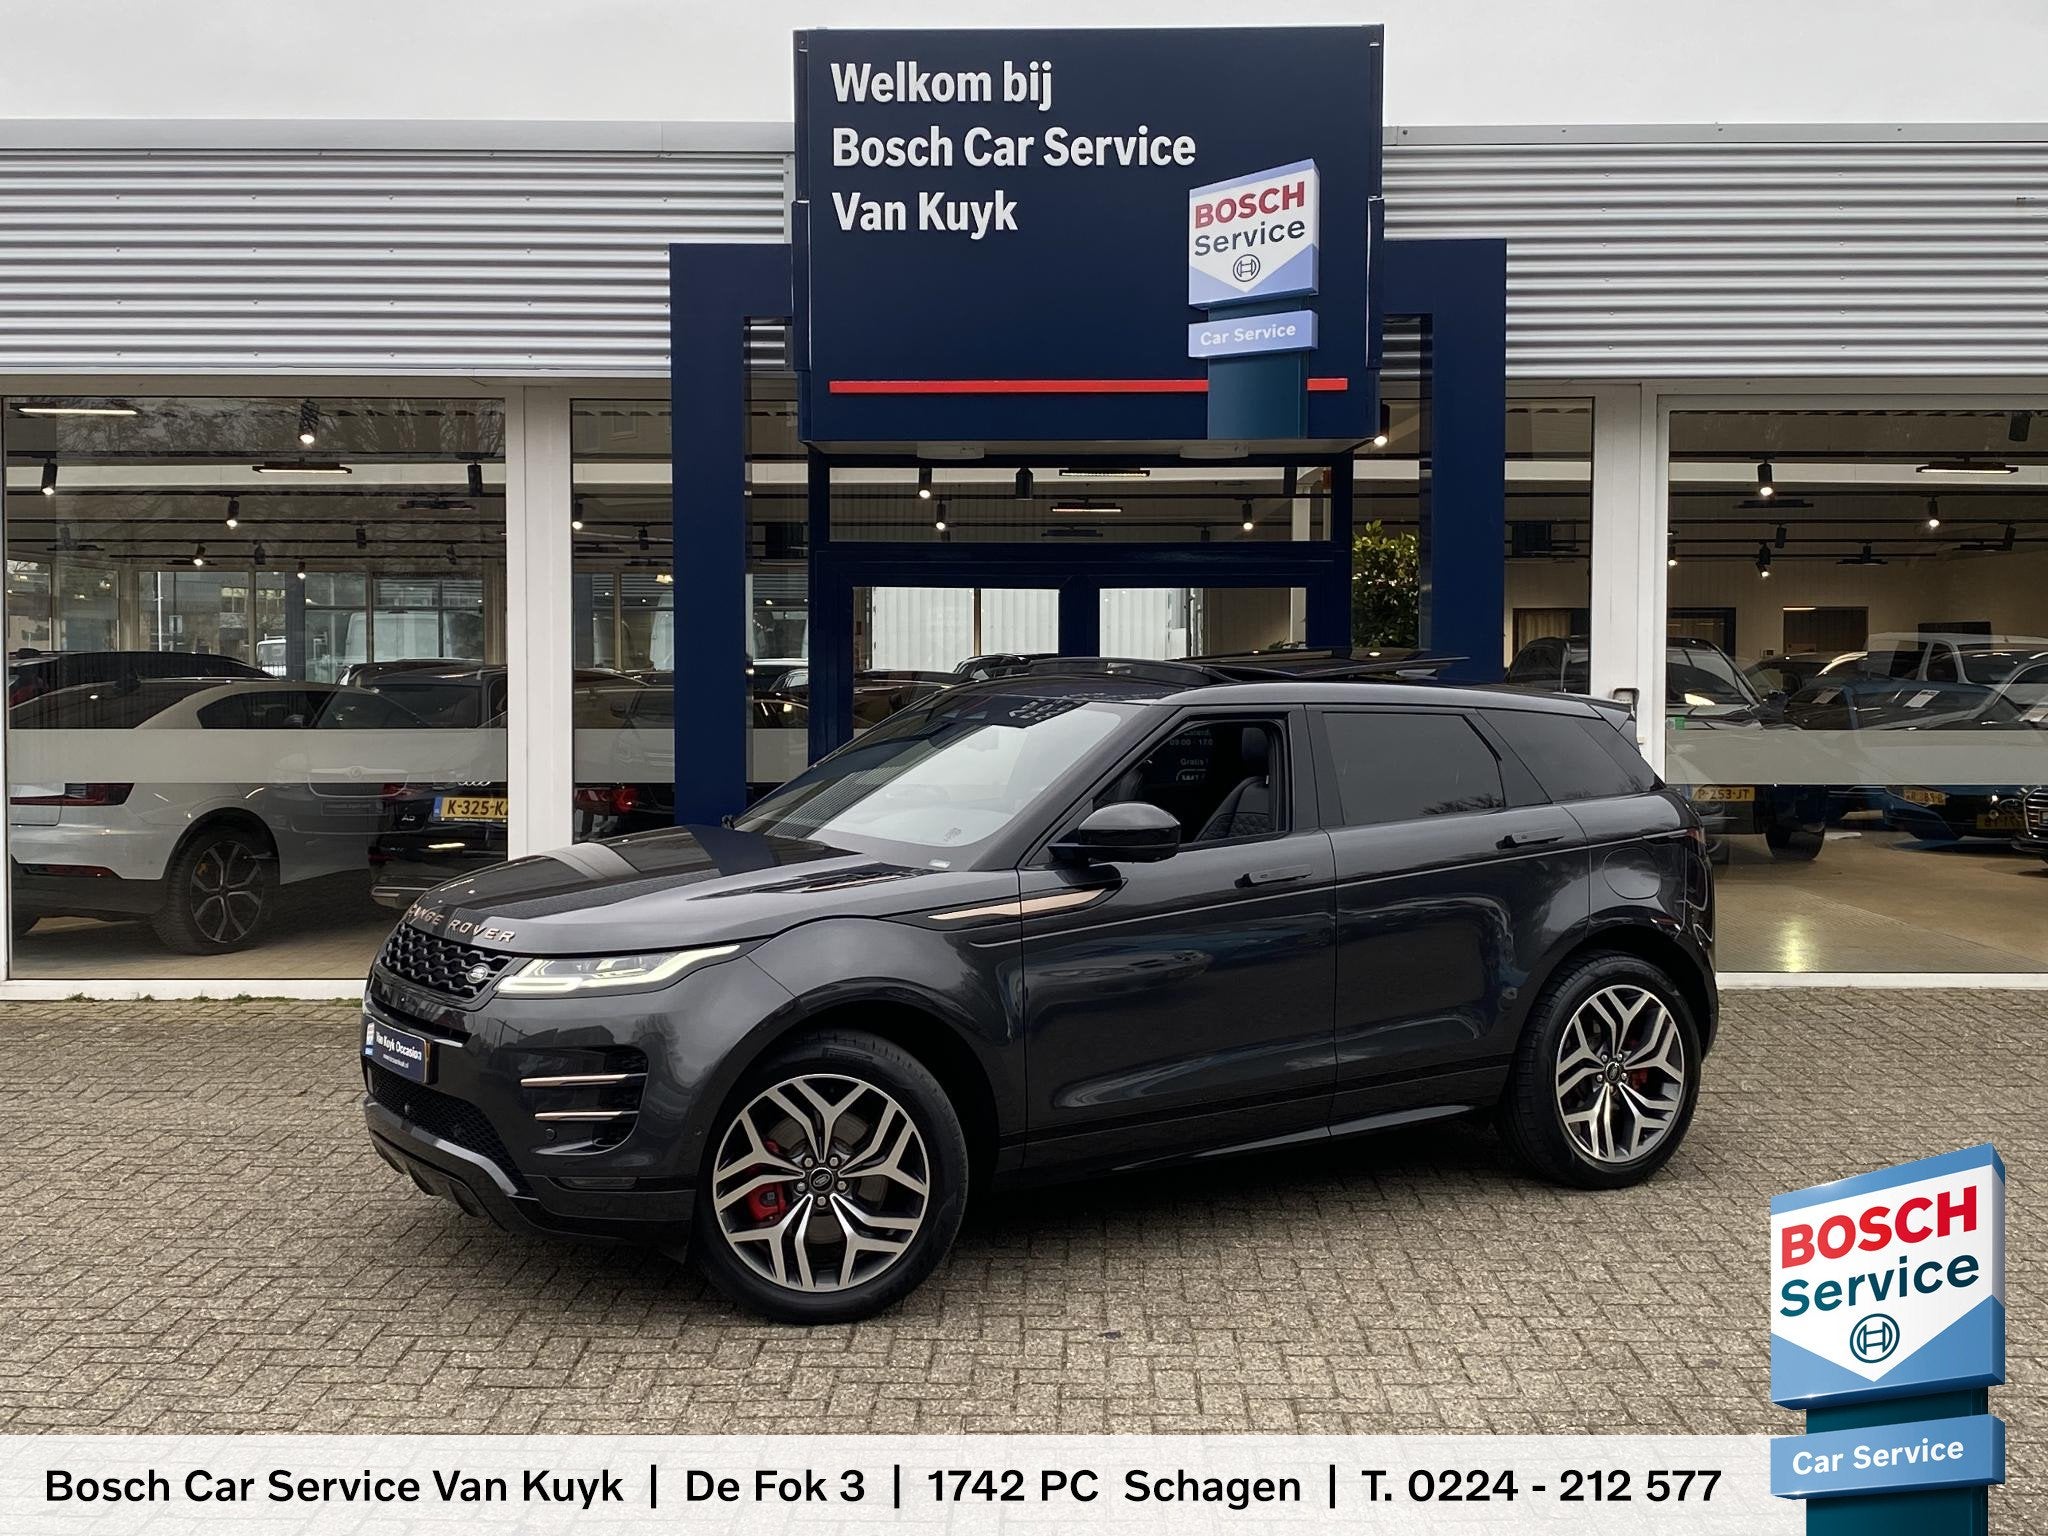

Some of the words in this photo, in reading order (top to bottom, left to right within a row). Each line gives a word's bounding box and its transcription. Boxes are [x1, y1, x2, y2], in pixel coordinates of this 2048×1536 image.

[831, 61, 991, 103] Welkom
[1003, 60, 1053, 112] bij
[833, 125, 953, 167] Bosch
[964, 126, 1035, 167] Car
[1043, 125, 1196, 167] Service
[832, 191, 906, 231] Van
[919, 189, 1018, 240] Kuyk
[1195, 181, 1305, 229] BOSCH
[1194, 220, 1305, 256] Service
[1200, 332, 1228, 346] Car
[1234, 323, 1297, 342] Service
[447, 799, 509, 816] K-325-K
[448, 919, 516, 944] ROVER
